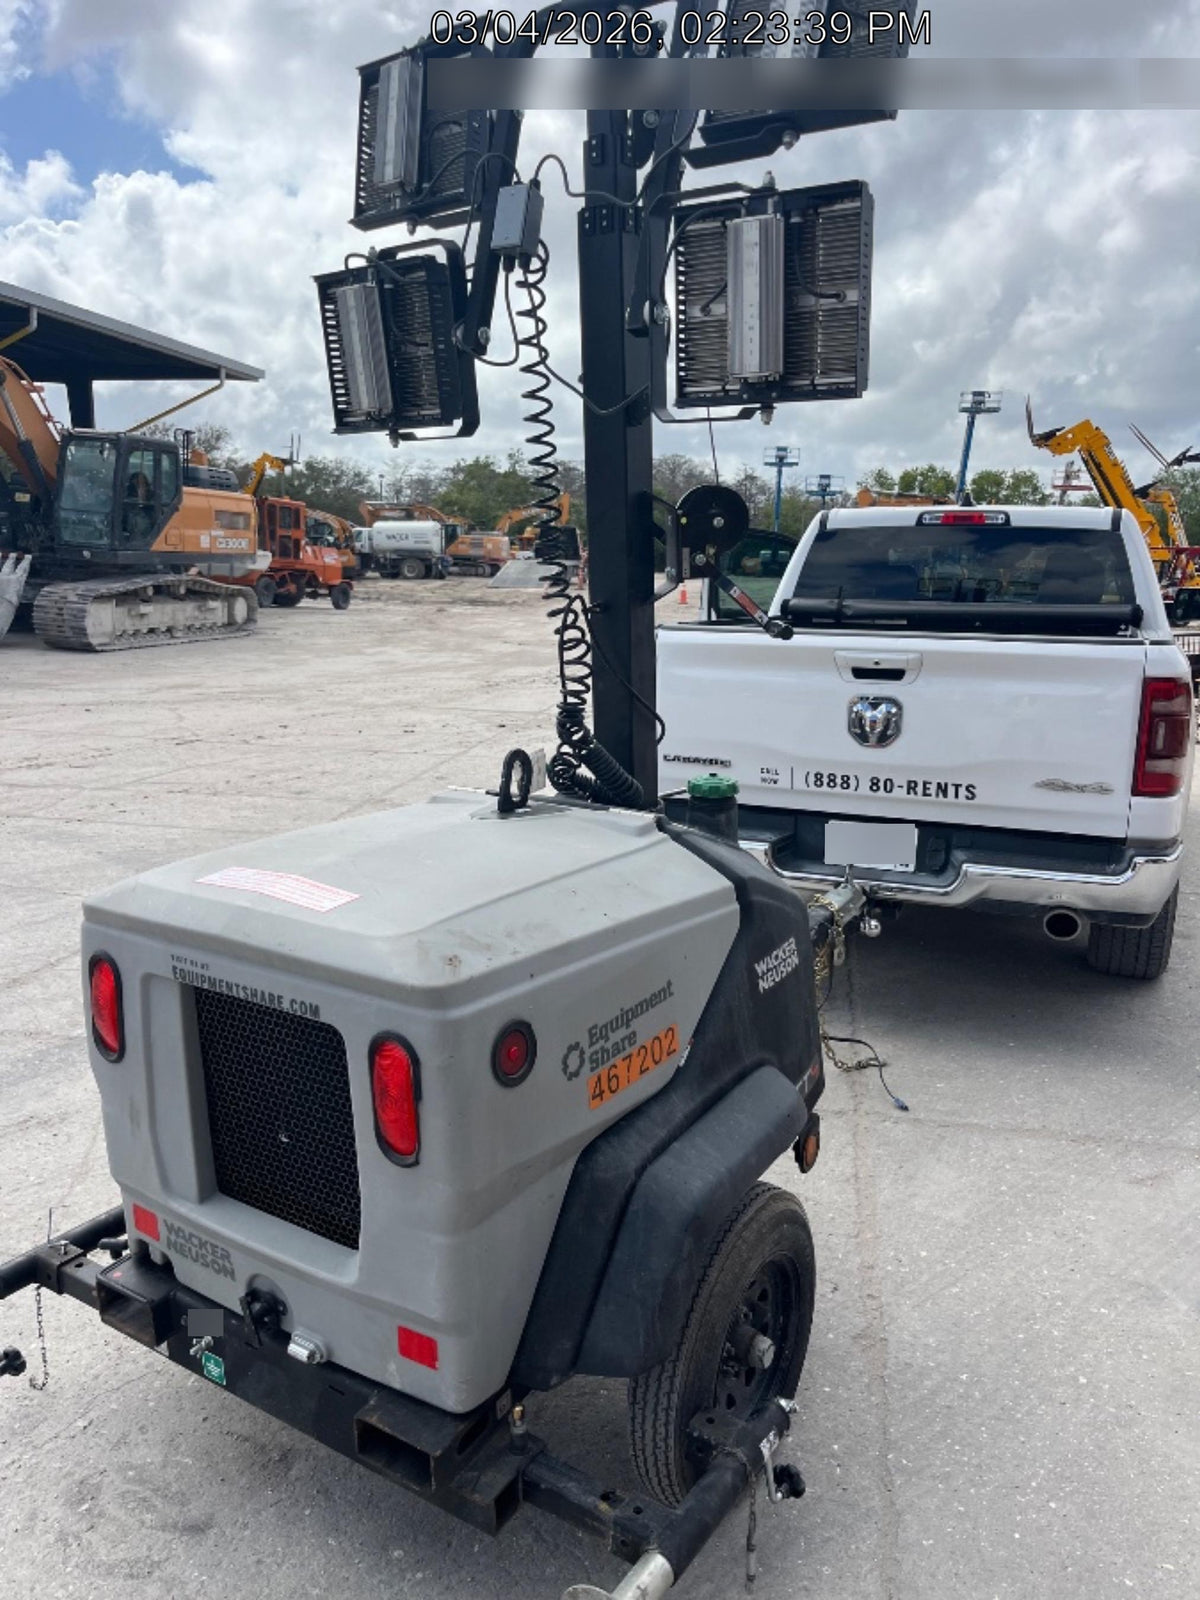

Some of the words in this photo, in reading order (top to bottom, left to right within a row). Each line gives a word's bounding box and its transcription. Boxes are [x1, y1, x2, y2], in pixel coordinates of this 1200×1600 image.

[804, 771, 860, 792] (888)
[869, 777, 977, 800] 80-RENTS
[754, 937, 797, 976] WACKER
[758, 950, 799, 994] NEUSON
[172, 965, 320, 1019] EQUIPMENTSHARE.COM
[587, 979, 674, 1048] Equipment
[589, 1030, 637, 1072] Share
[591, 1027, 676, 1101] 467202
[163, 1218, 233, 1266] WACKER
[166, 1236, 236, 1282] NEUSON
